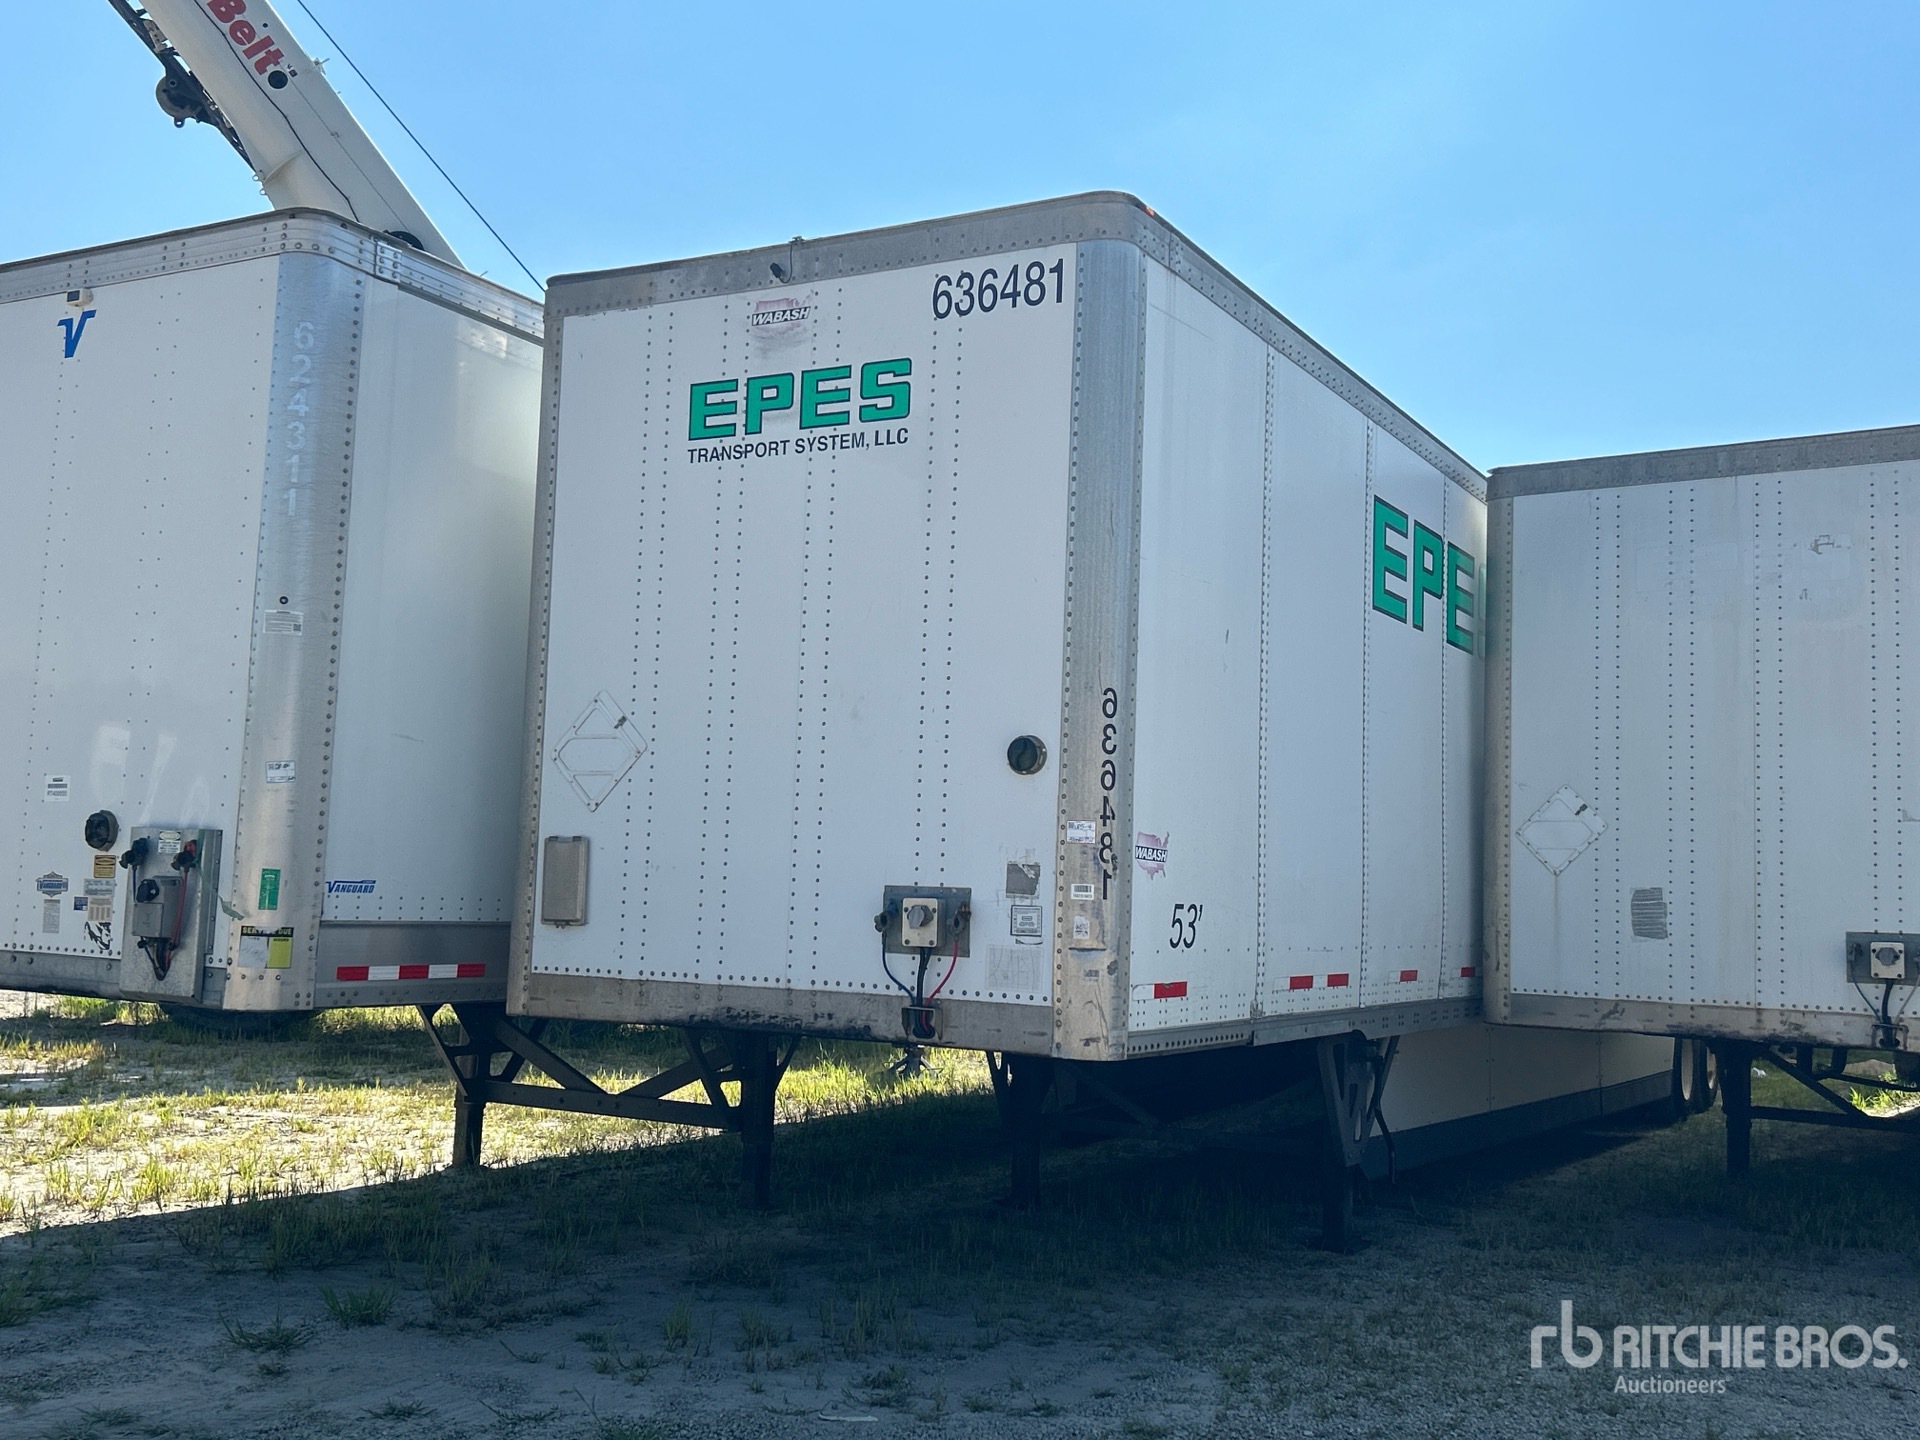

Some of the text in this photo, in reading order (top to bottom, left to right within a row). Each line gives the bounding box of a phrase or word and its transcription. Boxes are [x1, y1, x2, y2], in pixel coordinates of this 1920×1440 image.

[207, 0, 284, 75] Belt
[932, 258, 1064, 320] 636481
[751, 306, 811, 326] WABASH
[283, 321, 315, 516] 624311
[688, 357, 912, 441] EPES
[687, 428, 909, 464] TRANSPORT SYSTEM, LLC
[1135, 846, 1168, 863] WABASH
[325, 880, 377, 894] VANGUARD
[1169, 903, 1203, 949] 53'
